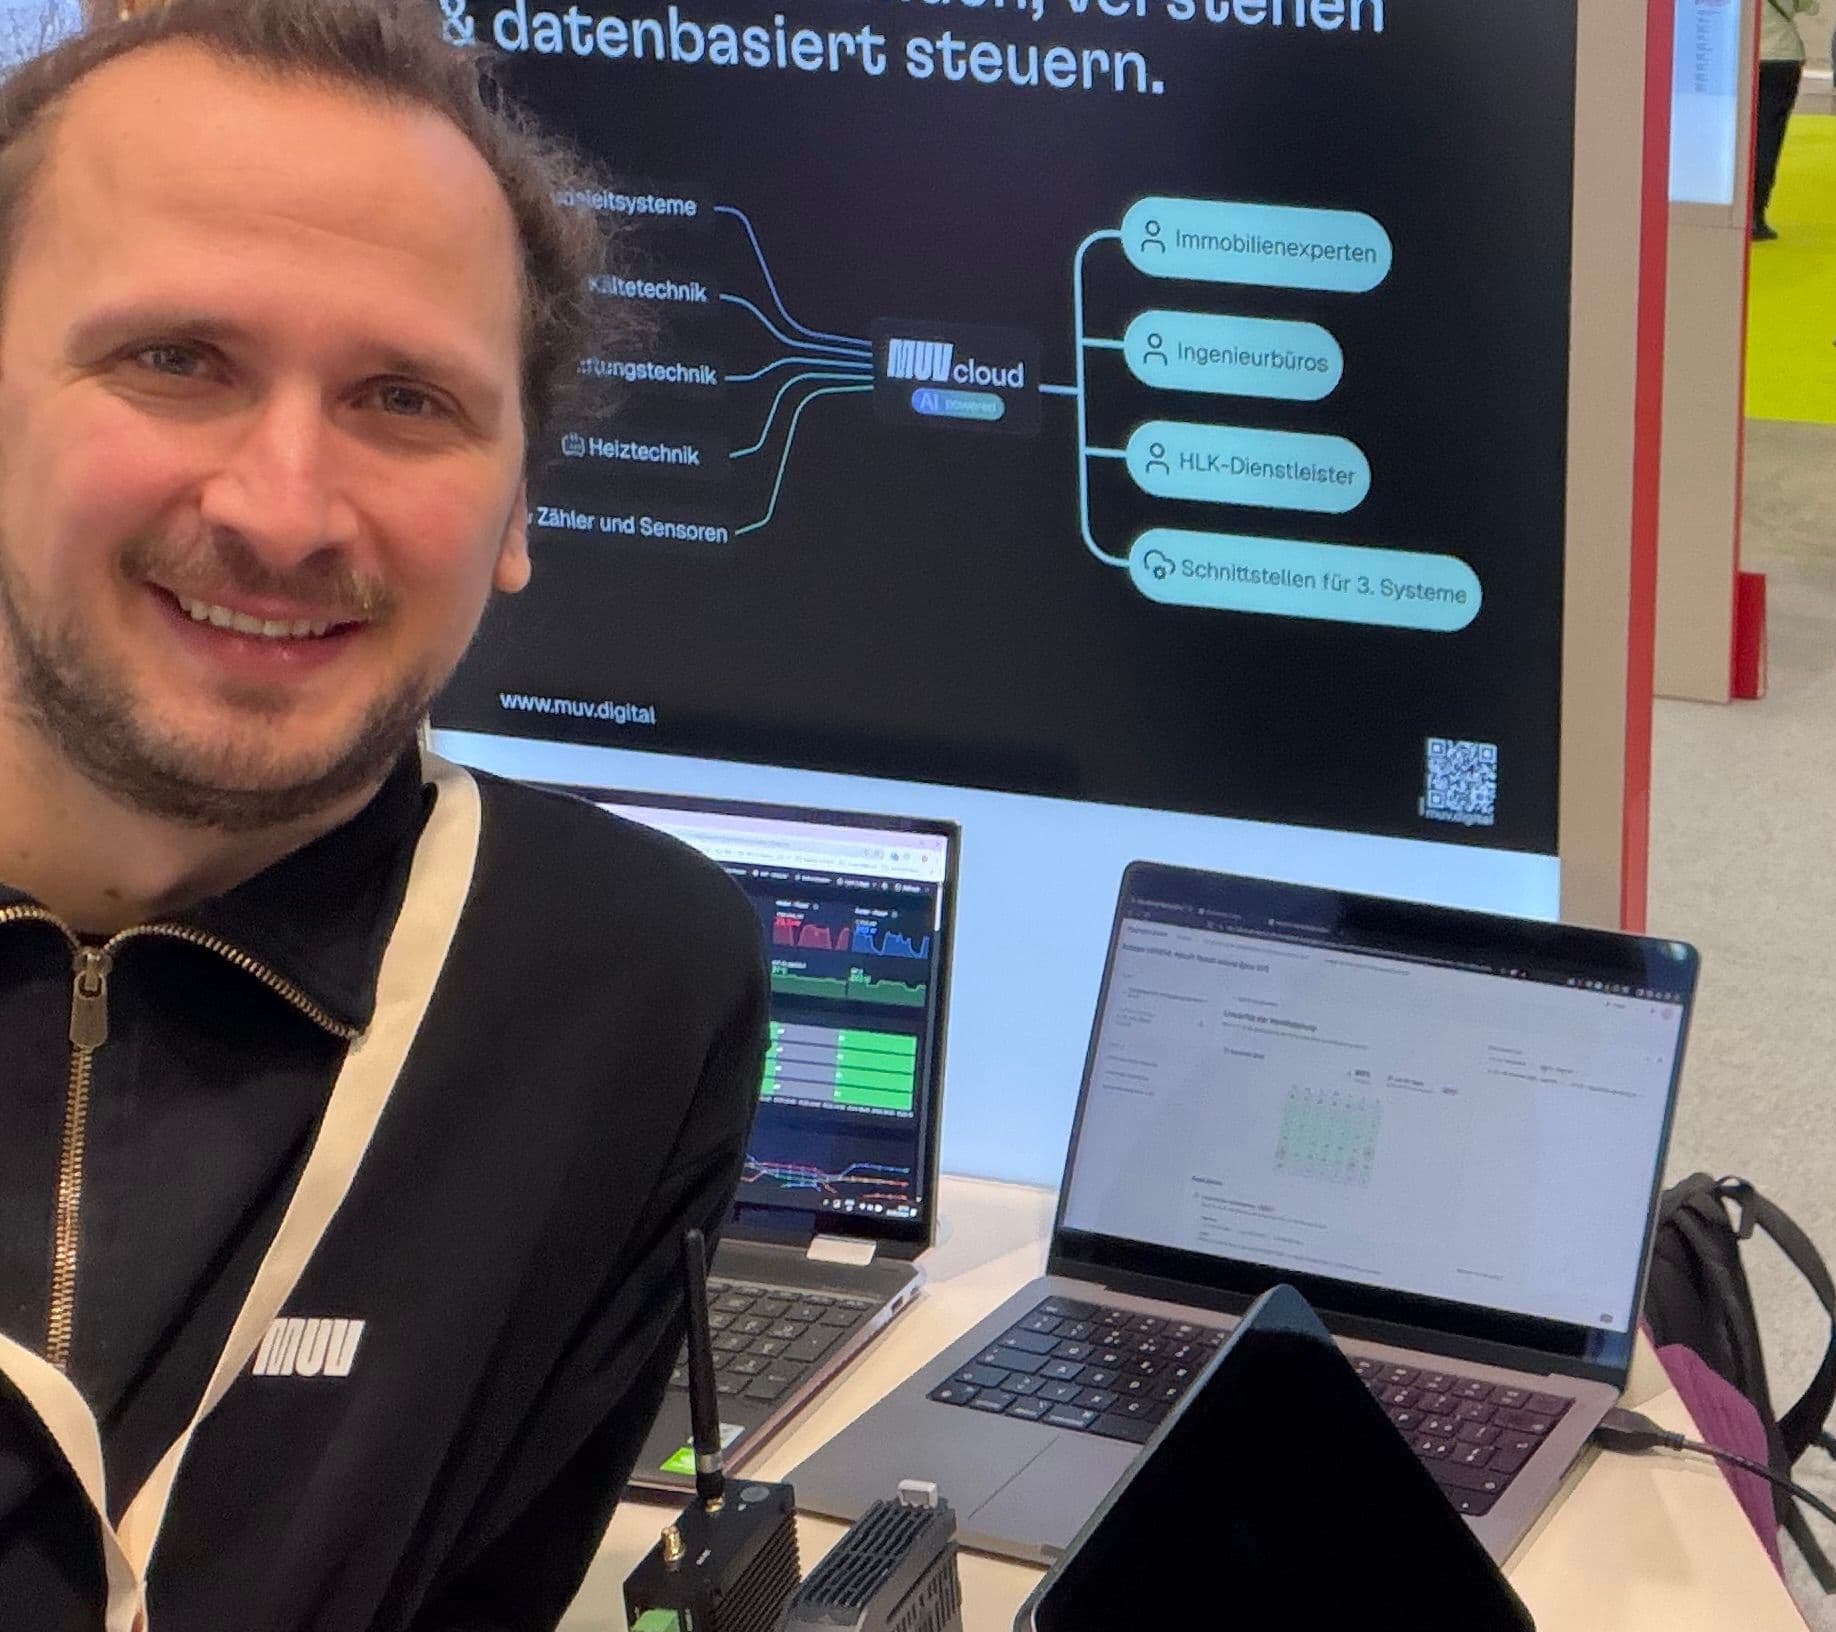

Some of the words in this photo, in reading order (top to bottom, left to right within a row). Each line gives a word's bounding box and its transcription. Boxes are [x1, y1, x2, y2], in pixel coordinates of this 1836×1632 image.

[906, 31, 1165, 95] steuern.
[1176, 229, 1377, 264] Immobilienexperten
[953, 358, 1025, 389] cloud
[1178, 341, 1329, 374] Ingenieurbüros
[919, 392, 939, 411] AI
[589, 437, 700, 466] Heiztechnik
[1180, 452, 1354, 485] HLK-Dienstleister
[537, 505, 595, 531] Zähler
[600, 514, 635, 536] und
[640, 517, 729, 545] Sensoren
[1181, 559, 1316, 590] Schnittstellen
[1323, 571, 1351, 594] für
[1357, 575, 1375, 597] 3.
[1380, 579, 1467, 605] Systeme
[499, 692, 657, 725] www.muv.digital
